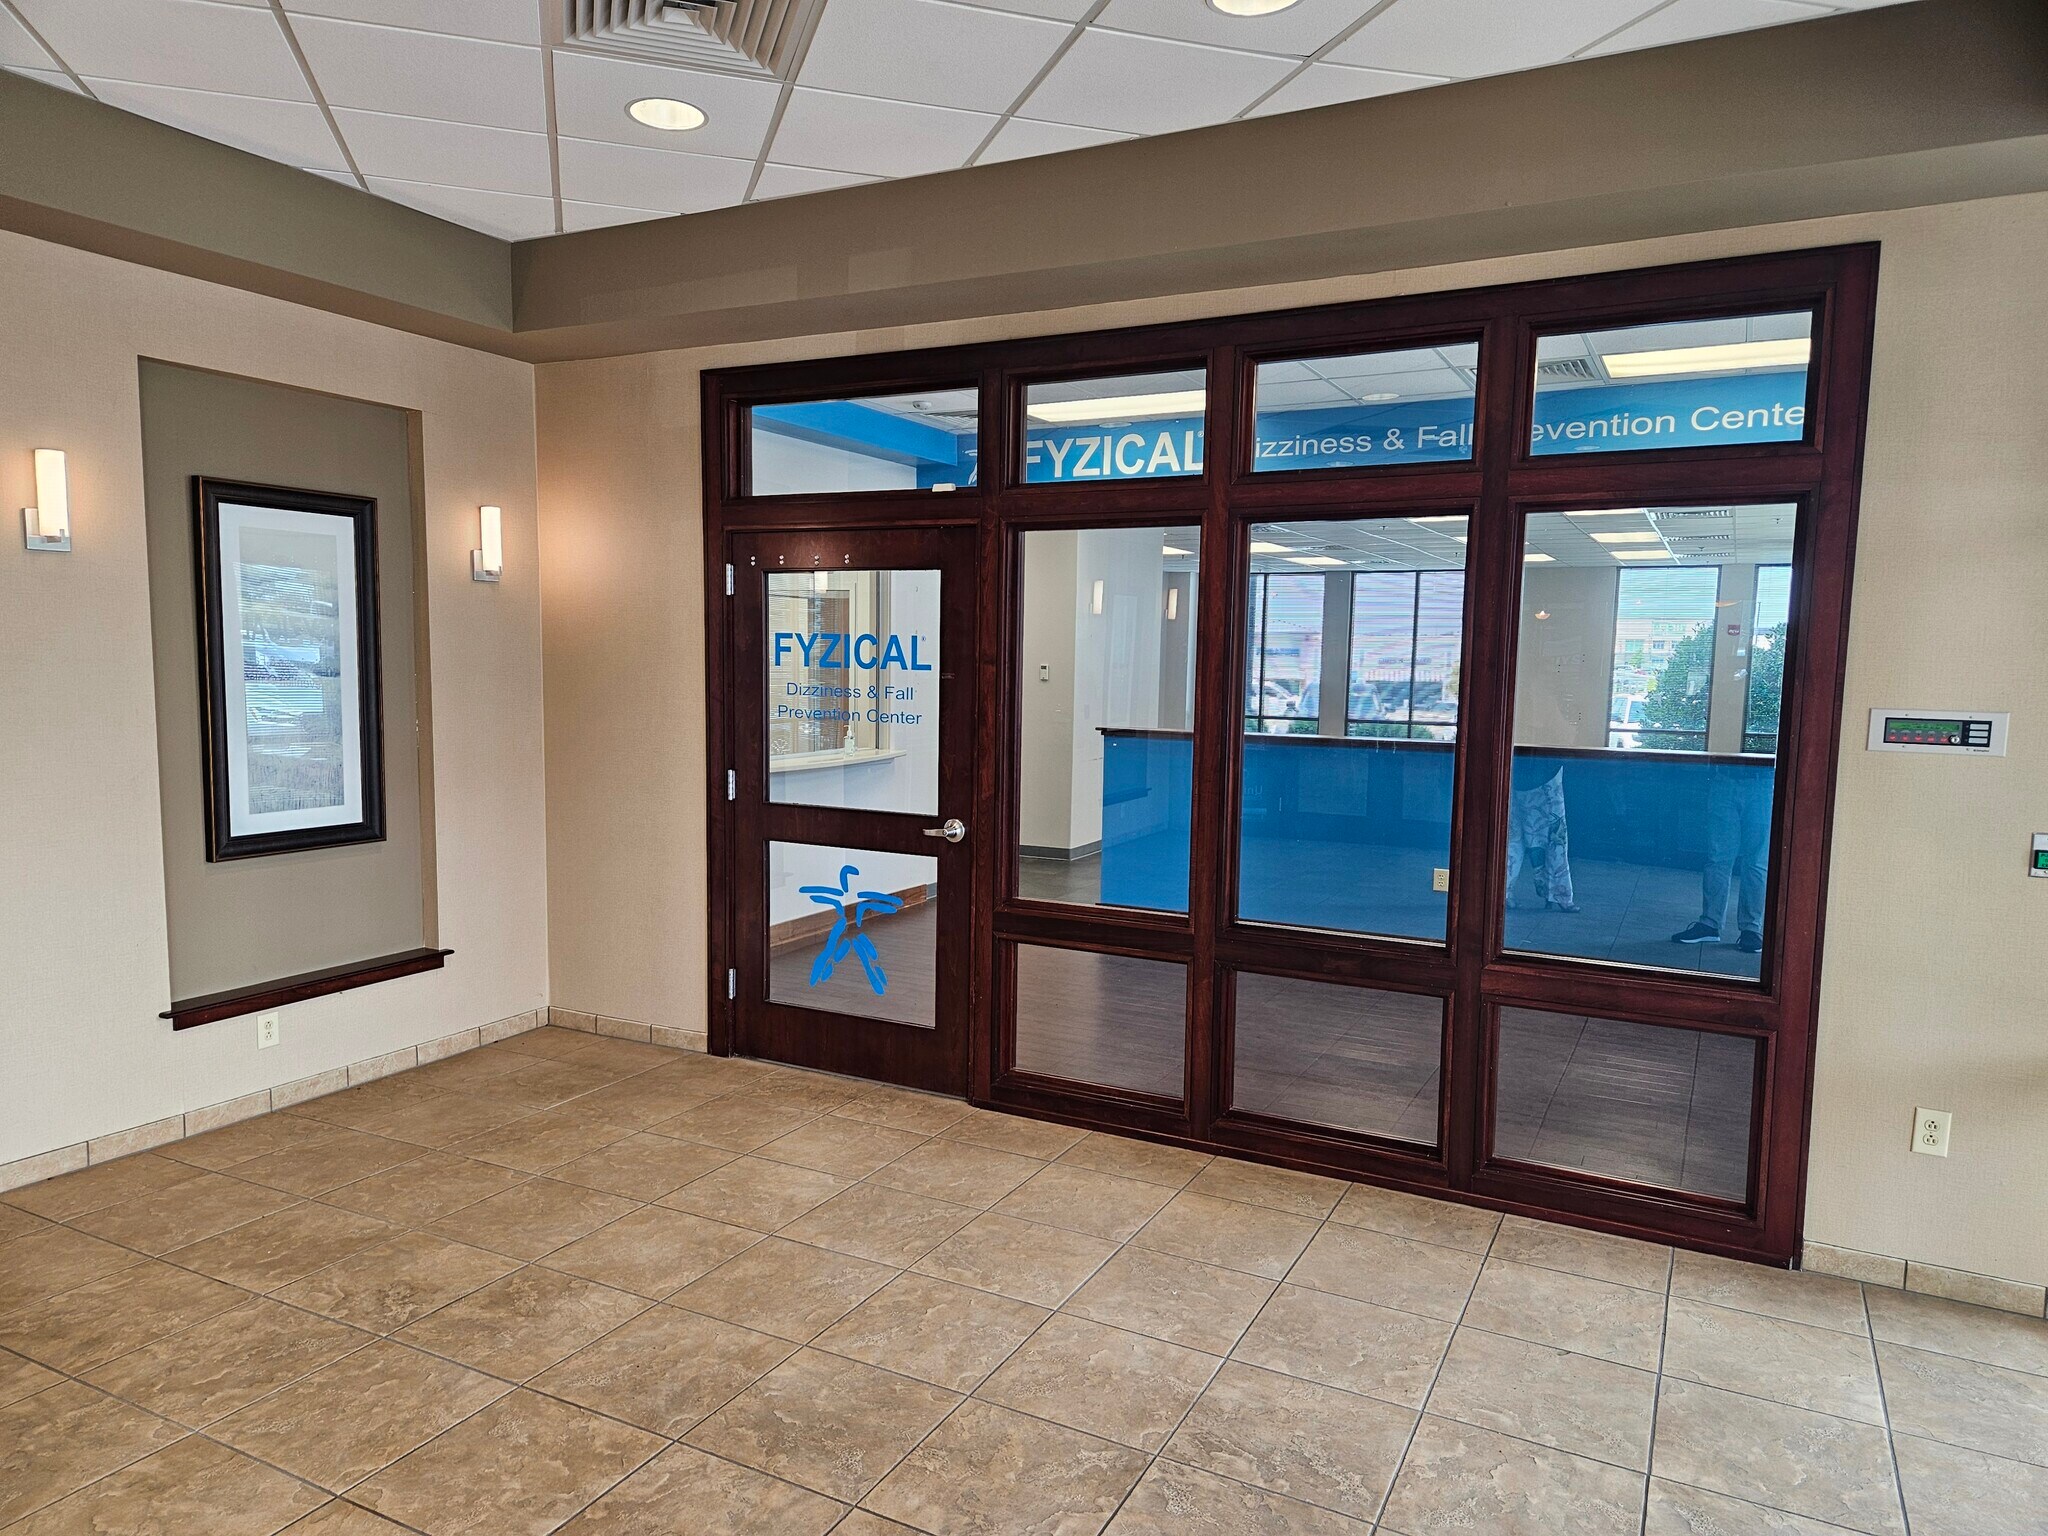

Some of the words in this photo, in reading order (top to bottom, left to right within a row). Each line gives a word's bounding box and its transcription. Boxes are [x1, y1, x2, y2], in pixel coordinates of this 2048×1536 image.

[1255, 434, 1372, 458] izziness
[1383, 428, 1405, 451] &
[1417, 423, 1474, 449] Fall
[1532, 412, 1676, 442] evention
[1691, 402, 1805, 431] Cente
[774, 632, 932, 671] FYZICAL
[786, 682, 862, 699] Dizziness
[866, 685, 880, 699] &
[885, 686, 914, 701] Fall
[778, 704, 861, 722] Prevention
[866, 708, 922, 725] Center
